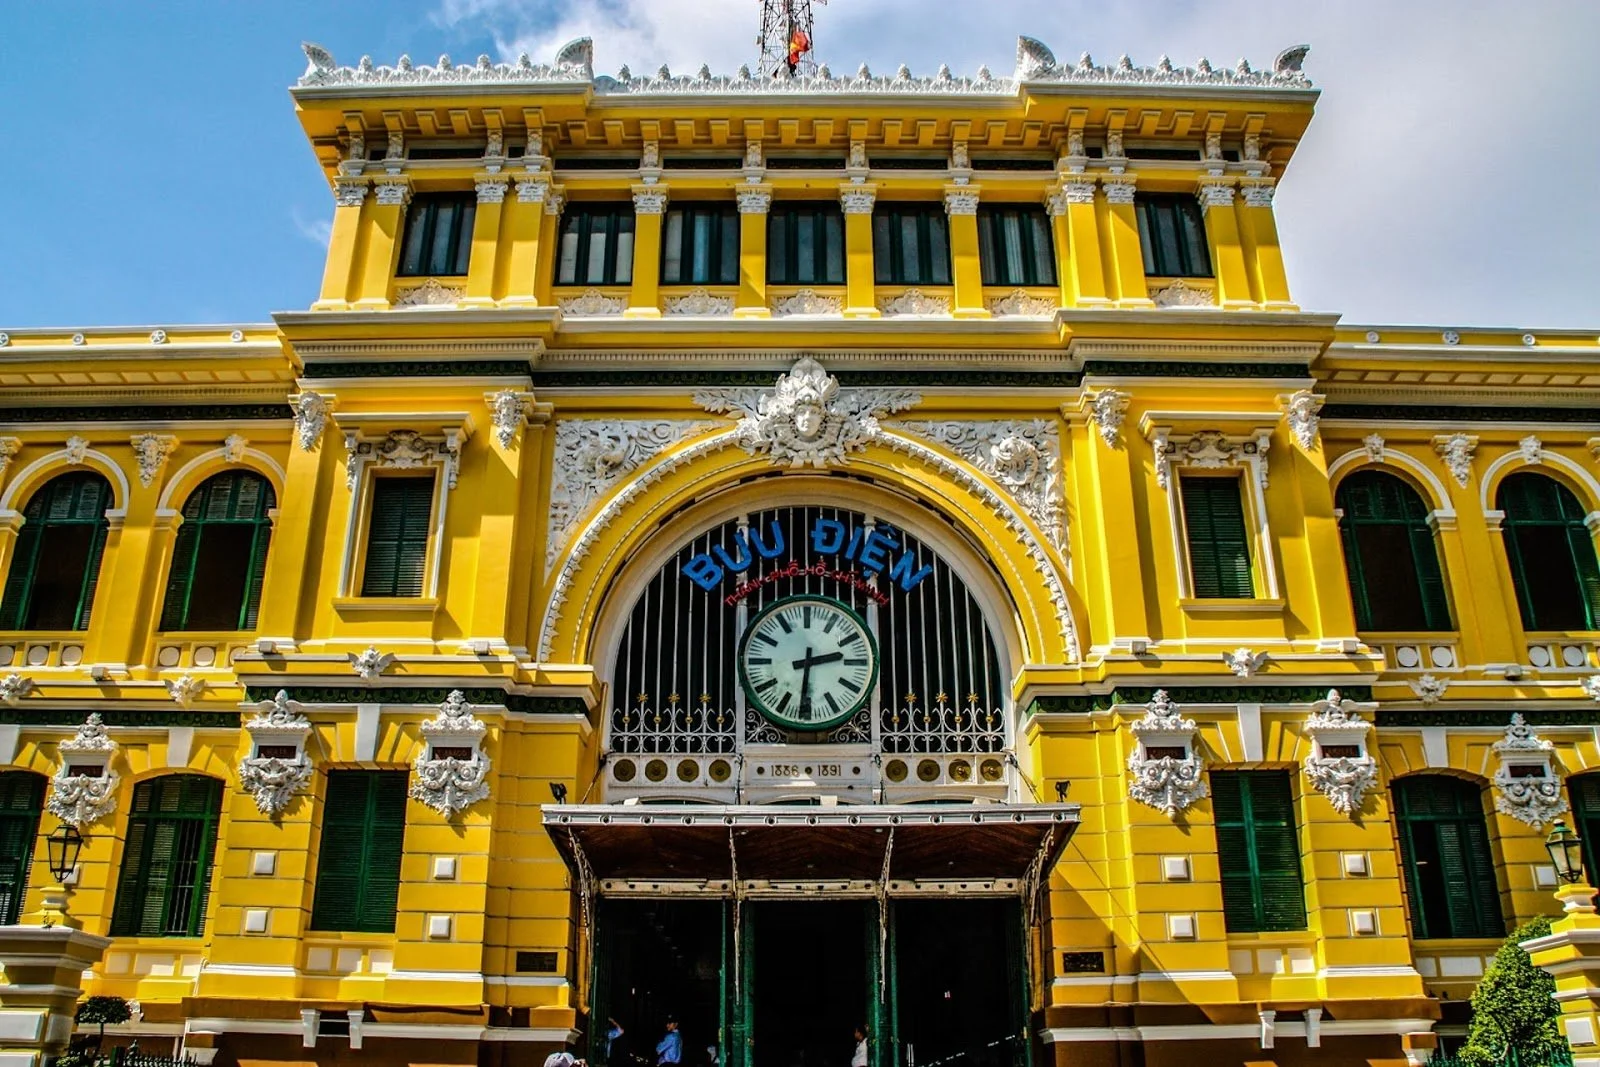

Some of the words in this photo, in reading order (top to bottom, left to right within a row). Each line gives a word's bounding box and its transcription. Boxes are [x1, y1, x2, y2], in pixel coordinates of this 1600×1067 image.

[810, 517, 933, 593] ĐIỆN
[771, 765, 801, 777] 1886
[818, 765, 842, 777] 1891
